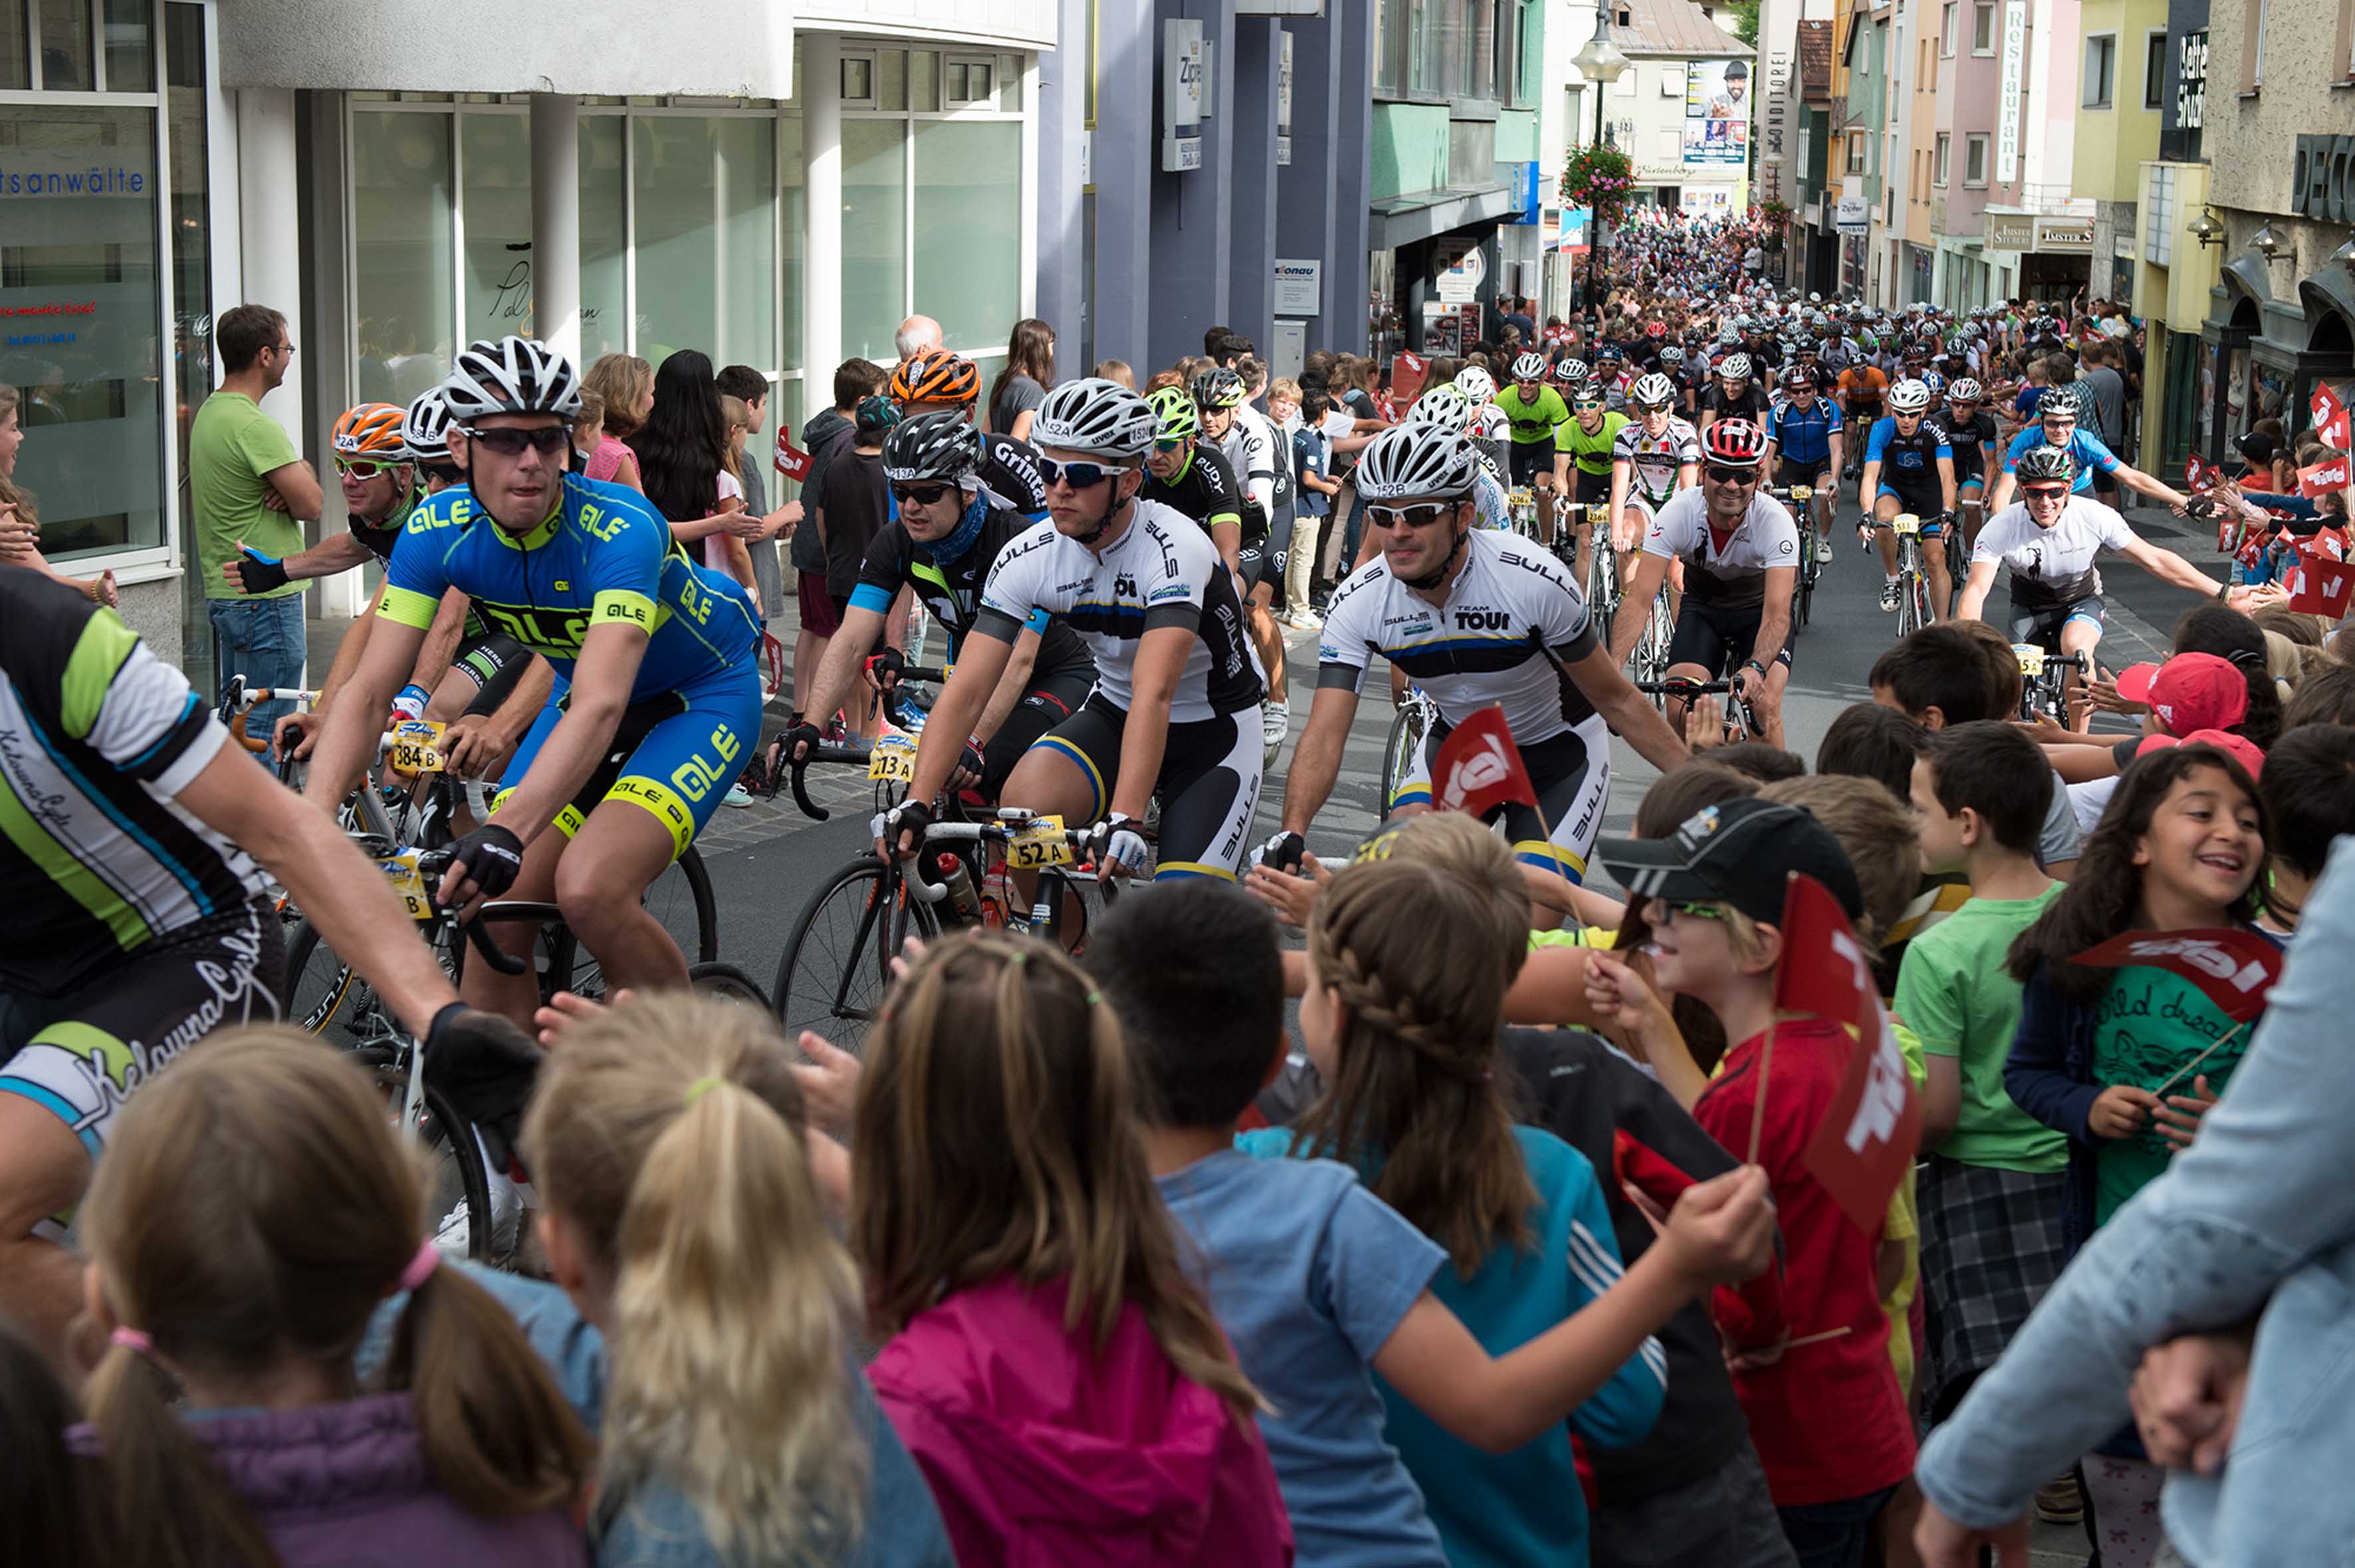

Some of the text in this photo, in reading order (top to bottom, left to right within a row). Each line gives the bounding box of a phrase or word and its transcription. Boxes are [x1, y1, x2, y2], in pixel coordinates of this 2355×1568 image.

[2003, 10, 2023, 173] Restaurant
[2043, 229, 2081, 243] IMSTER
[1092, 429, 1116, 445] uvex
[1196, 457, 1225, 495] RUDY
[1428, 471, 1449, 489] uvex
[1376, 484, 1406, 496] 152B
[987, 531, 1055, 589] BULLS
[1145, 520, 1178, 580] BULLS
[1499, 551, 1581, 606] BULLS
[1385, 612, 1430, 626] BULLS
[426, 752, 435, 766] B
[901, 764, 909, 777] A
[1572, 762, 1609, 842] BULLS
[1221, 774, 1258, 861] BULLS
[1018, 842, 1062, 864] 52 A
[406, 895, 420, 914] B
